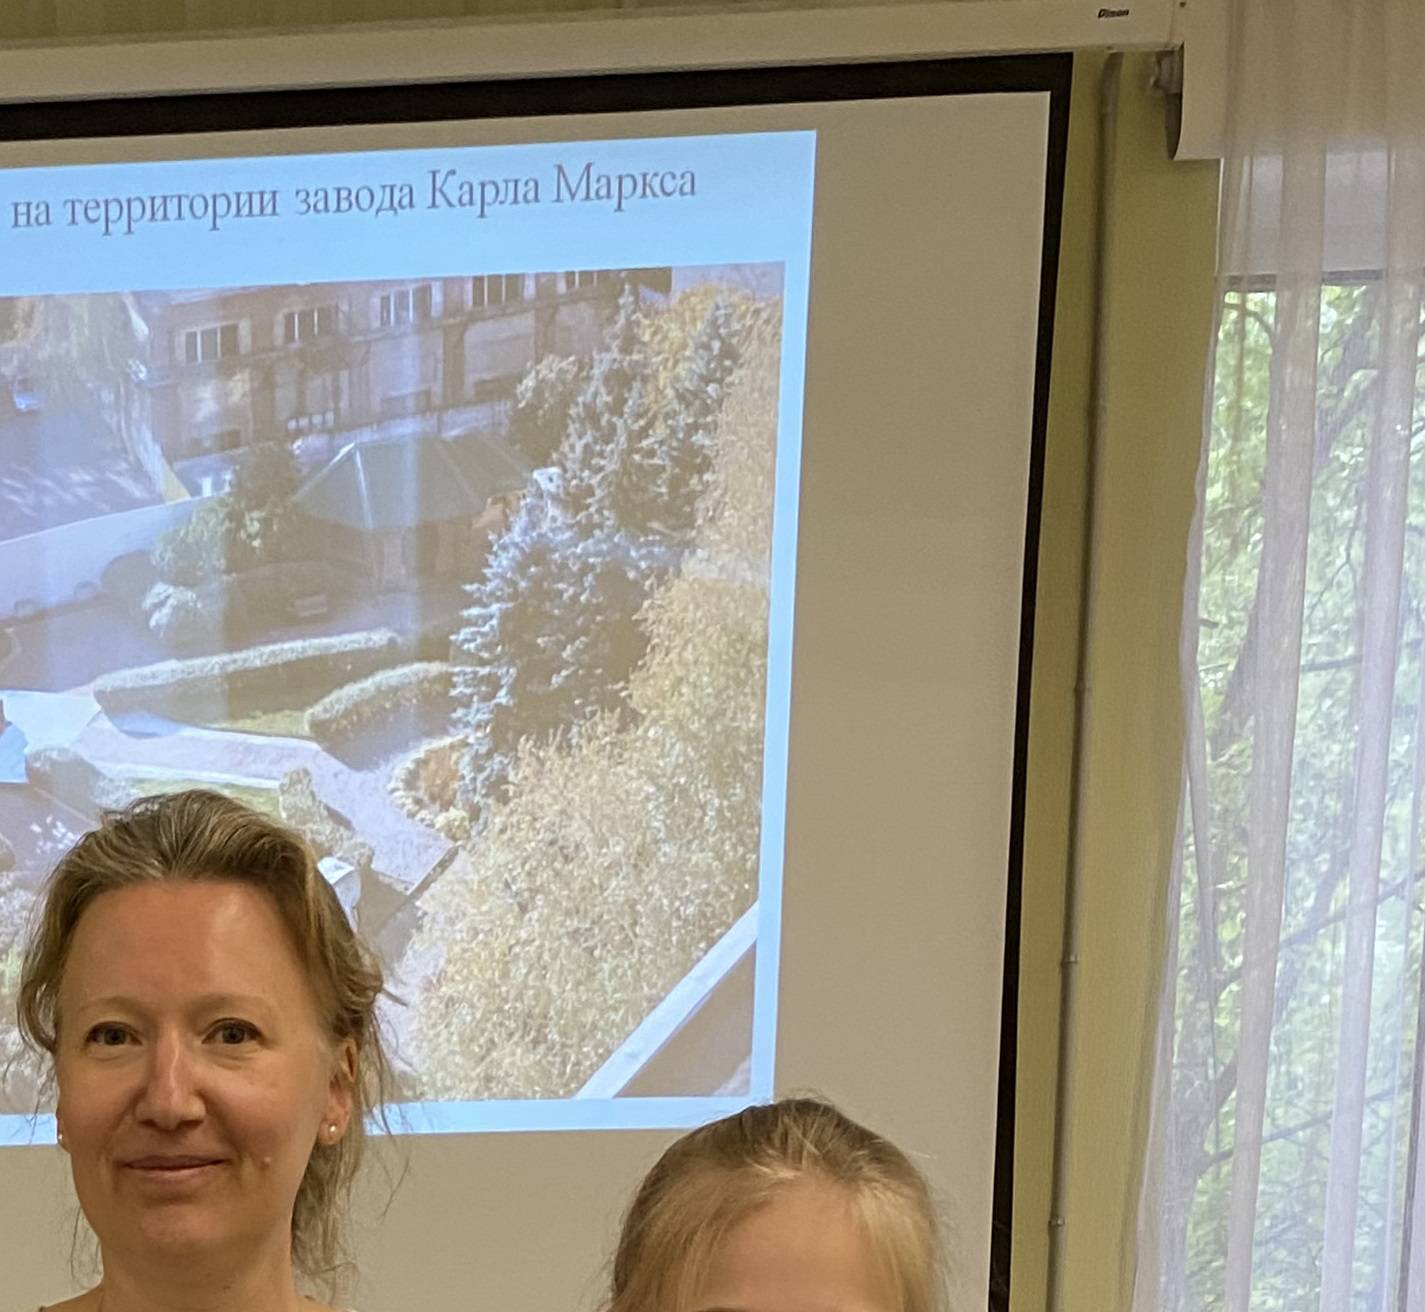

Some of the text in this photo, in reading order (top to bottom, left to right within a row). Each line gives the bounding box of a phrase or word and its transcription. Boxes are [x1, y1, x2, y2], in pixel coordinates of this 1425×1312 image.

[11, 199, 52, 229] на
[64, 188, 280, 235] территории
[294, 180, 417, 216] завода
[427, 168, 542, 218] Карла
[552, 162, 697, 212] Маркса
